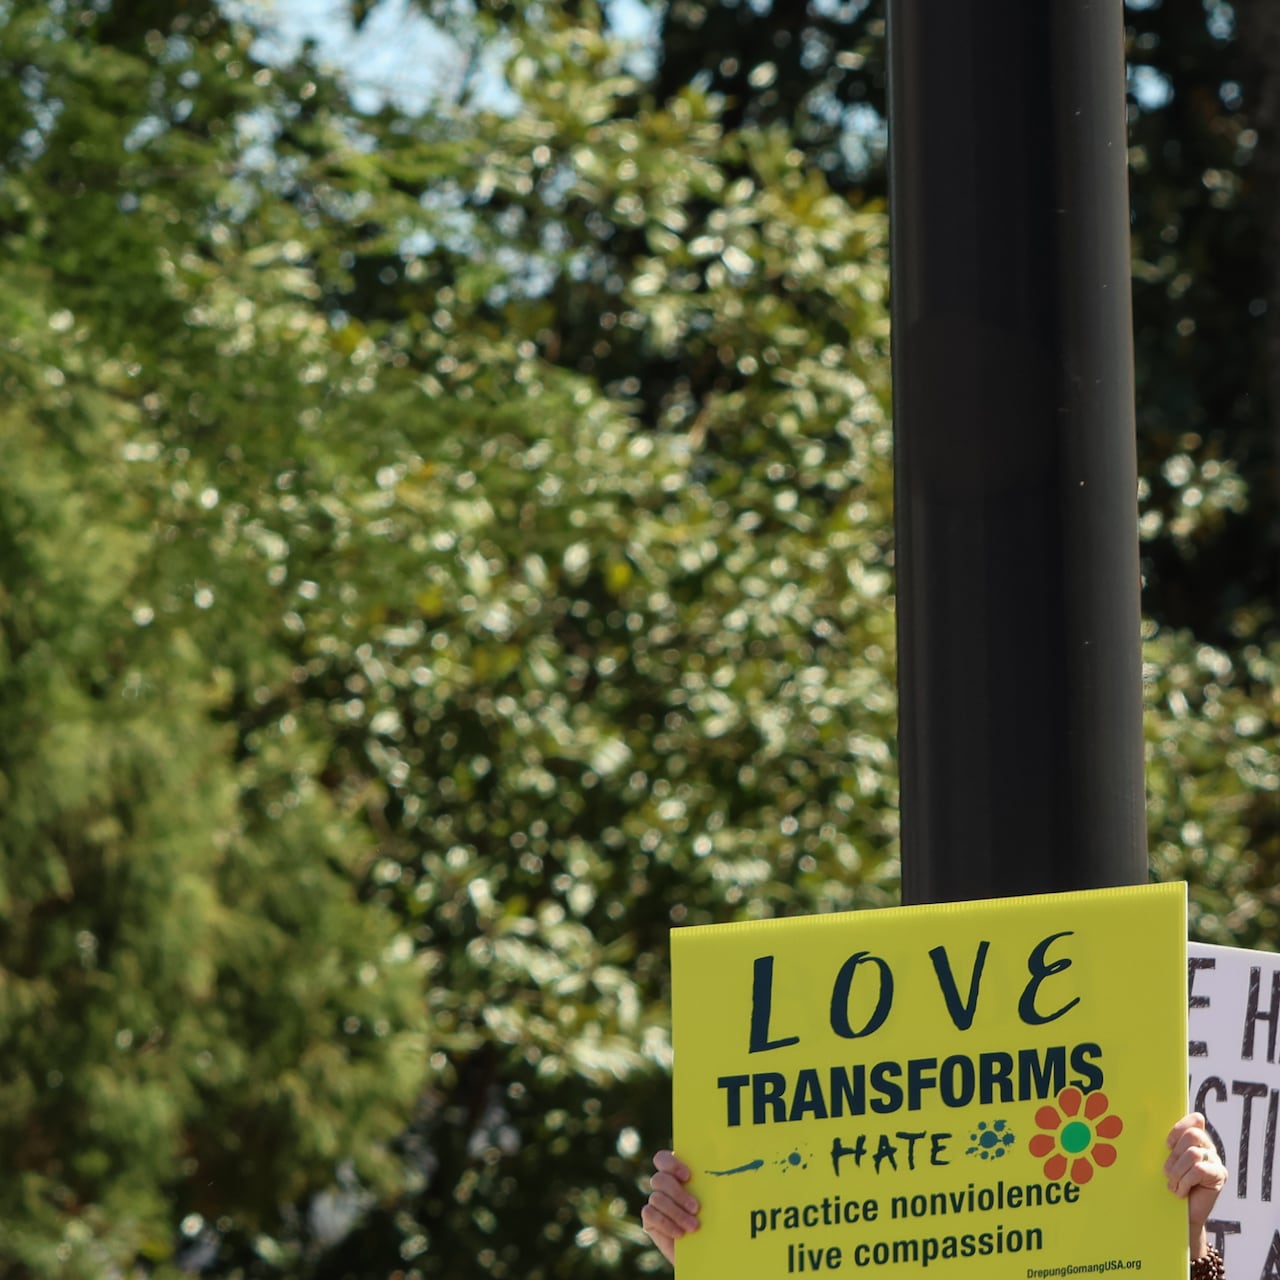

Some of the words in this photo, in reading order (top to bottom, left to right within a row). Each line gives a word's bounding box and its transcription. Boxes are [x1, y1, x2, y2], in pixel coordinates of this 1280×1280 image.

[748, 930, 1082, 1054] LOVE
[716, 1042, 1104, 1128] TRANSFORMS
[830, 1130, 953, 1178] HATE
[749, 1193, 880, 1239] practice
[891, 1179, 1082, 1226] nonviolence
[786, 1241, 843, 1274] live
[853, 1224, 1044, 1268] compassion
[1026, 1259, 1142, 1280] DrepungGomangUSA.org
